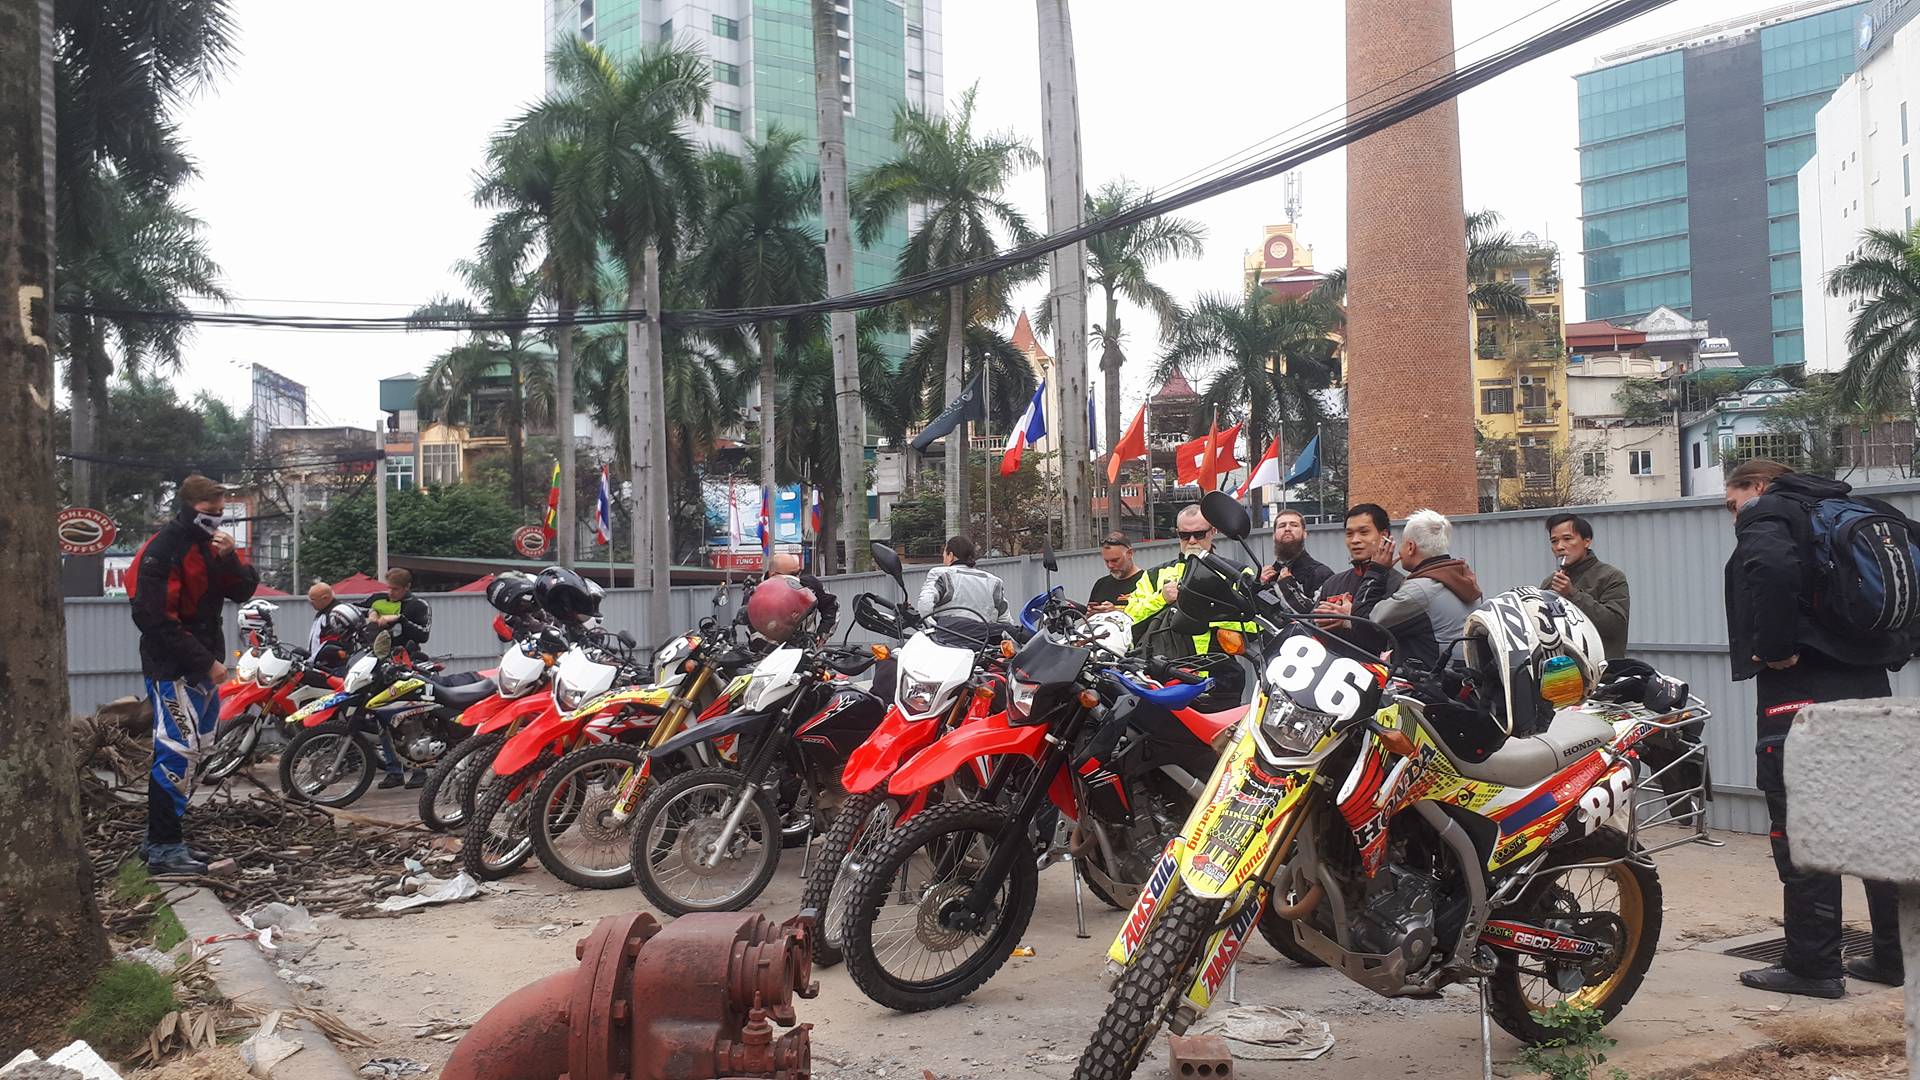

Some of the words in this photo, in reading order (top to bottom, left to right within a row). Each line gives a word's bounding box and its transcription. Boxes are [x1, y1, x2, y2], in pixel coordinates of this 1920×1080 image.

[58, 510, 113, 531] GHLANDS
[1265, 634, 1374, 722] 86
[1562, 737, 1601, 758] HONDA
[1220, 809, 1264, 825] HINSON
[1353, 743, 1436, 850] HONDA
[1186, 802, 1217, 851] Racing
[1234, 841, 1269, 885] Honda
[1120, 853, 1179, 961] AMSOIL
[1202, 898, 1261, 996] AMSOIL
[1513, 931, 1551, 949] GEICO
[1550, 936, 1594, 955] AMSOIL
